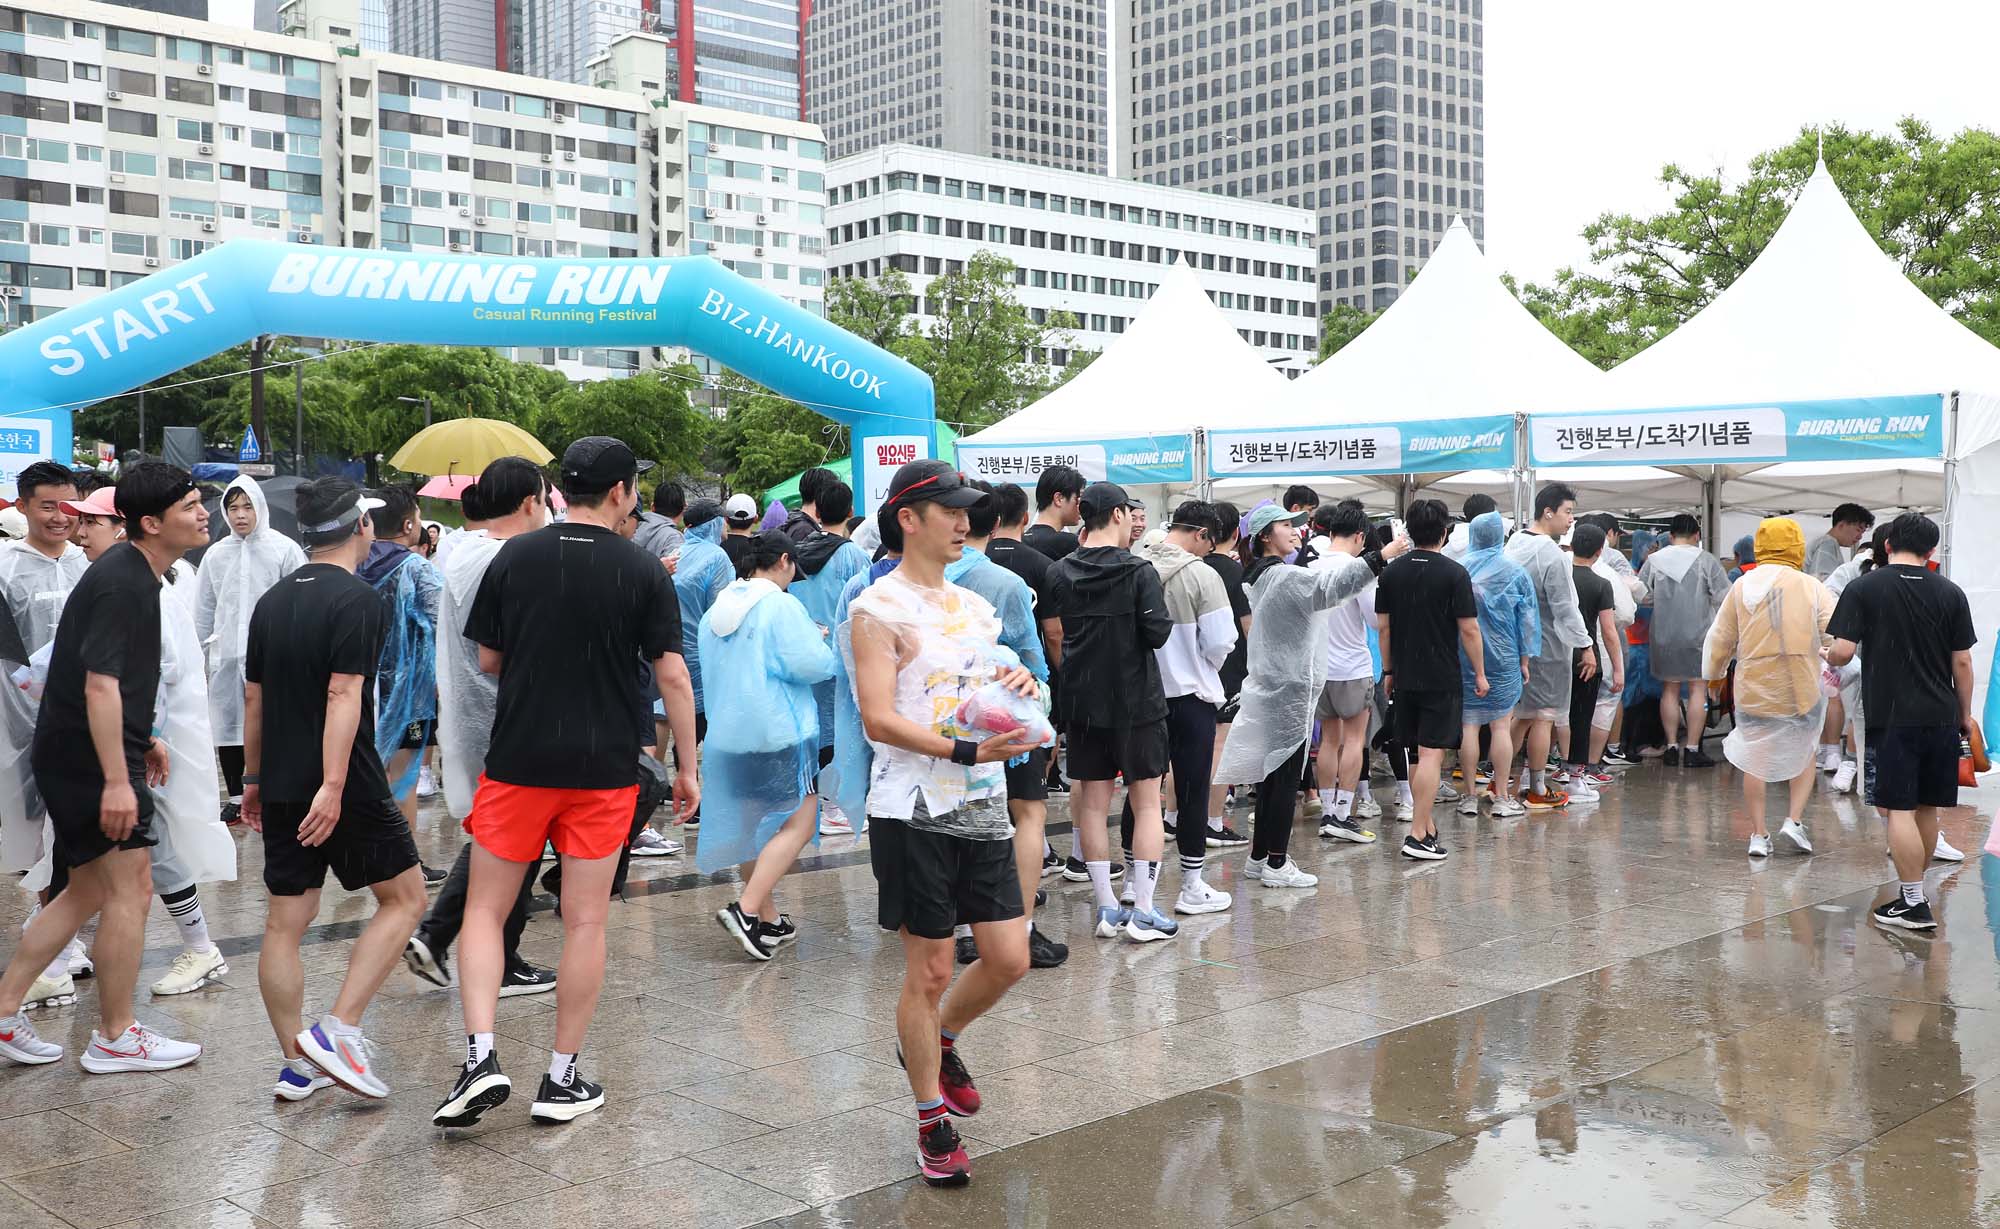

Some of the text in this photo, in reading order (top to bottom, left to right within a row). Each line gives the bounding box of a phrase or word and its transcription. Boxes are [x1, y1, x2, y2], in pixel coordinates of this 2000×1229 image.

[267, 253, 672, 305] BURNING RUN
[40, 272, 215, 376] START
[473, 307, 657, 324] Casual Running Festival
[1556, 421, 1753, 450] 진행본부/도착기념품
[1796, 415, 1931, 436] BURNING RUN
[1229, 438, 1377, 463] 진행본부/도착기념품
[1408, 432, 1506, 451] BURNING RUN
[1112, 450, 1185, 466] BURNING RUN
[467, 1044, 478, 1065] NIKE
[561, 1064, 574, 1086] NIKE
